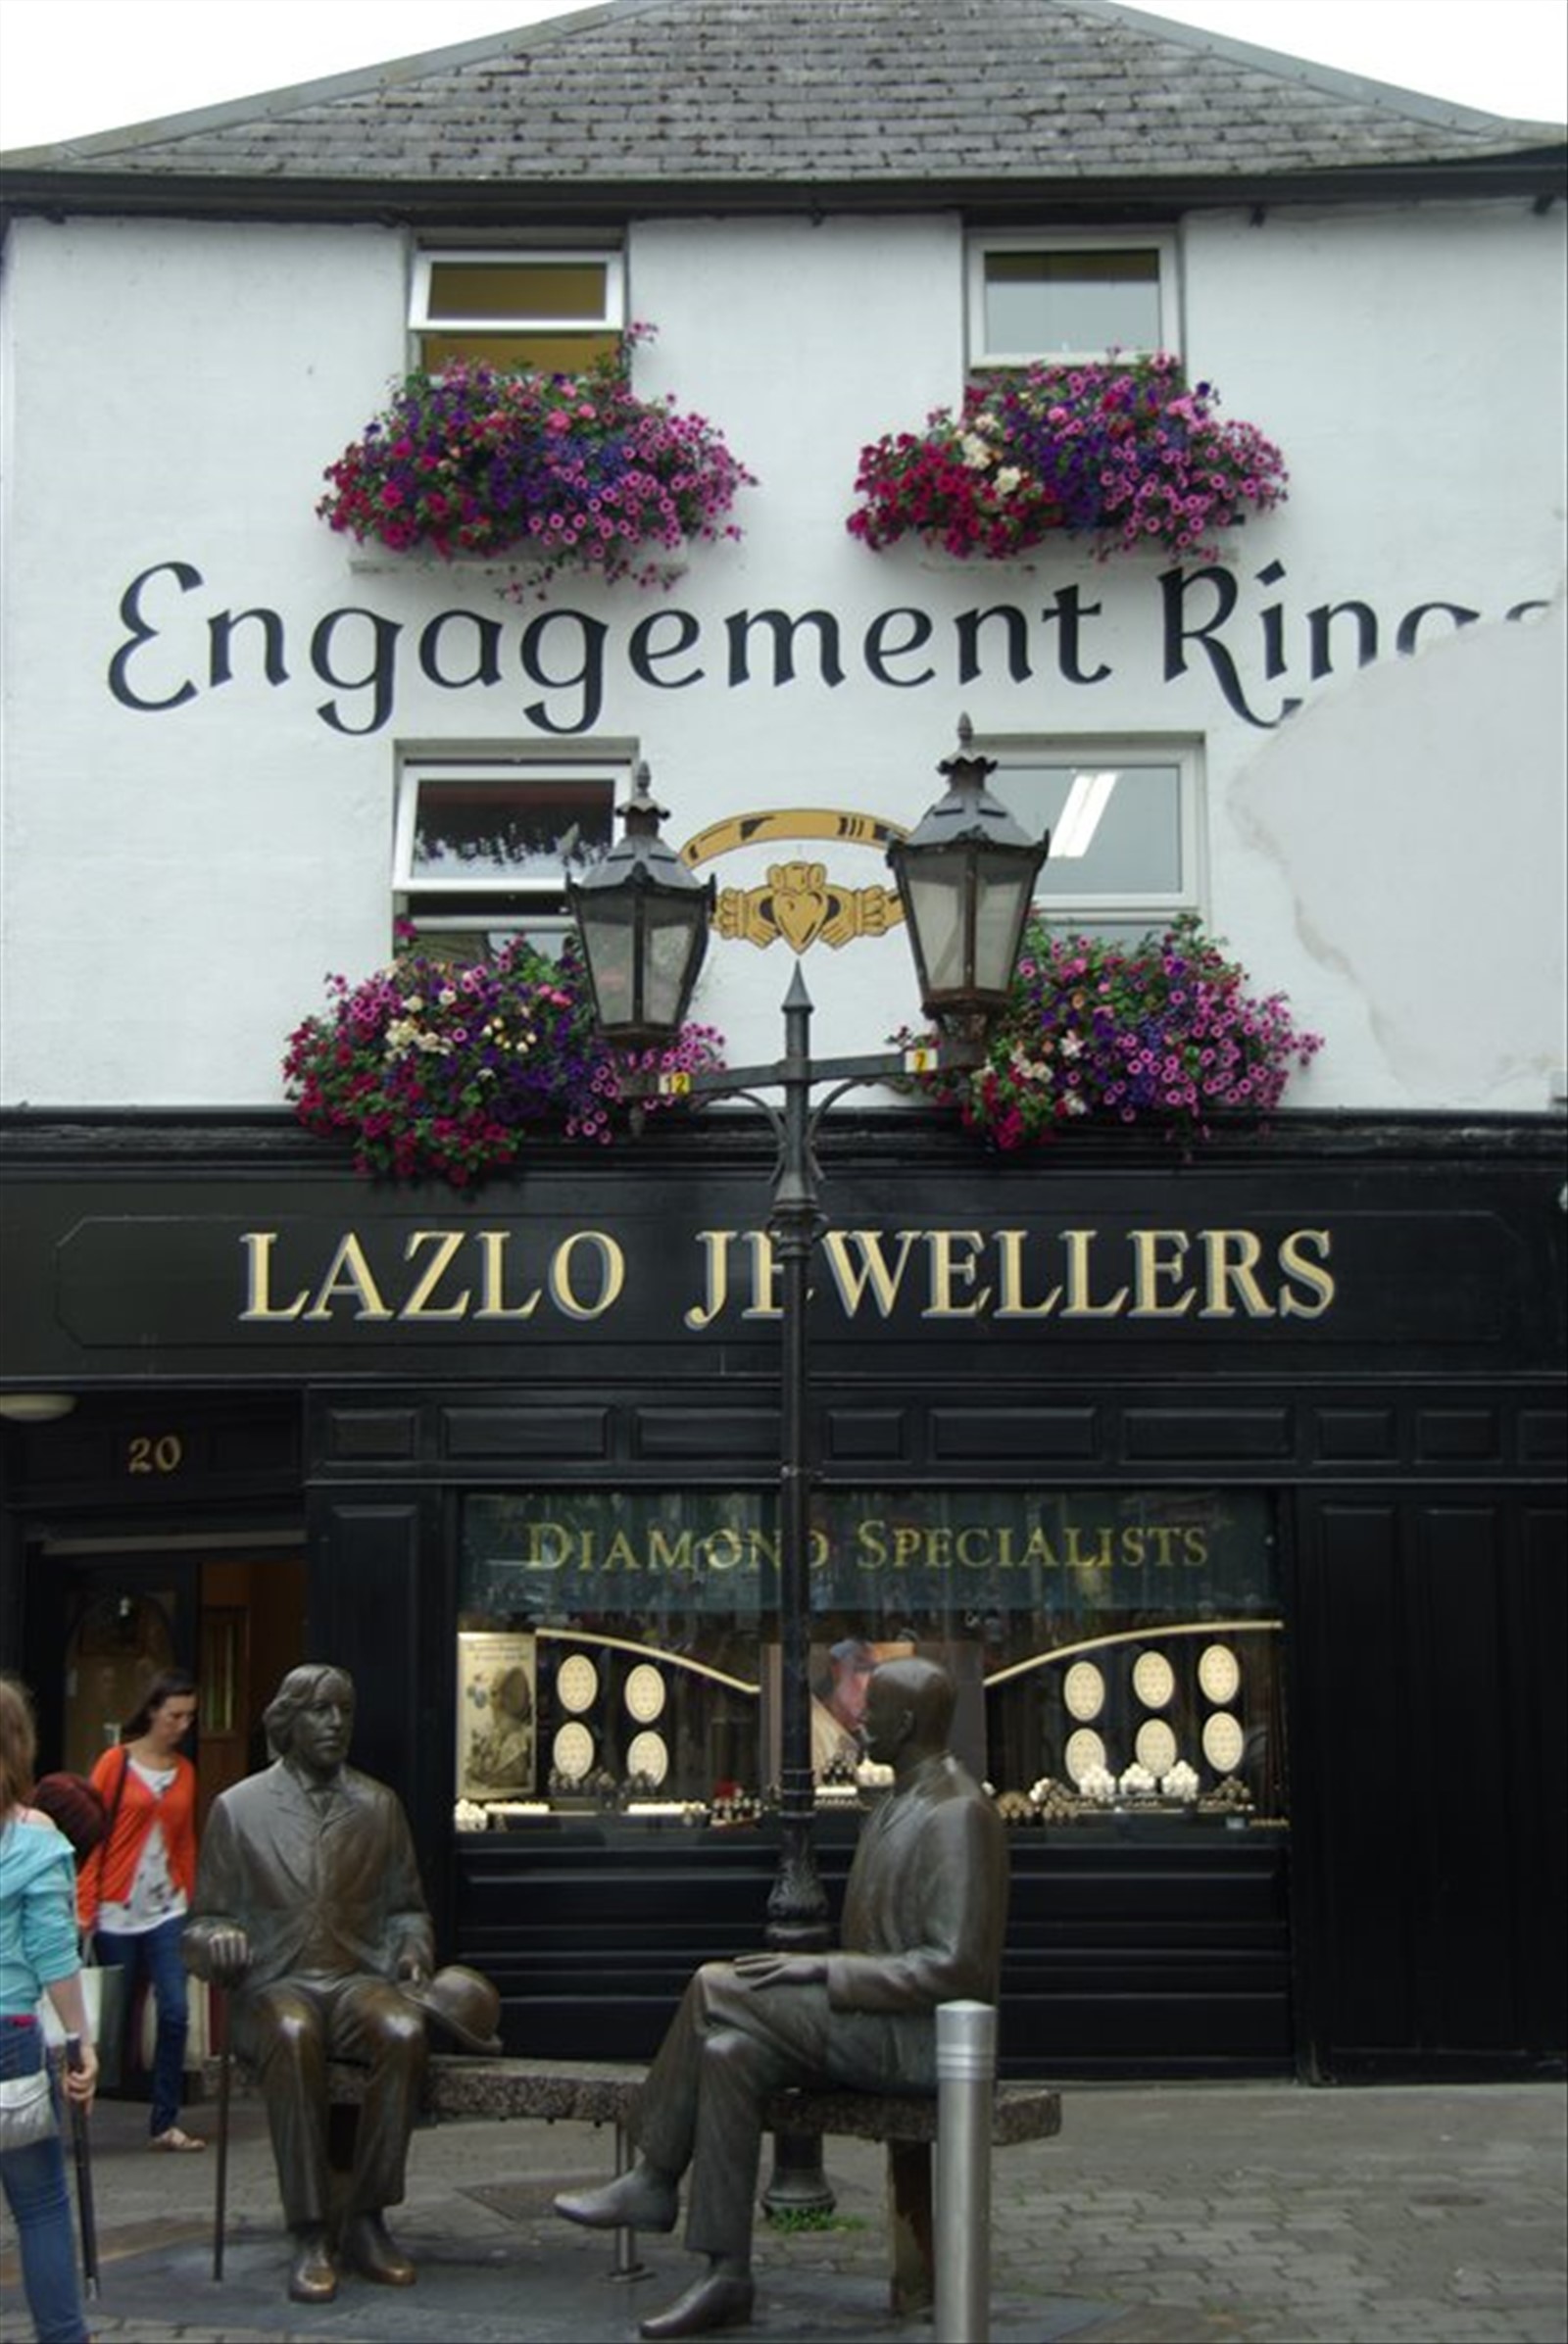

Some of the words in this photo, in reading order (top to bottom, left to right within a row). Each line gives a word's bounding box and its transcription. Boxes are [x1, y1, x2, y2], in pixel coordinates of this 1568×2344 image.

[108, 562, 1112, 735] Engagement
[1157, 559, 1551, 728] Rin
[238, 1231, 625, 1321] LAZLO
[128, 1435, 182, 1473] 20
[857, 1520, 1209, 1569] SPECIALISTS
